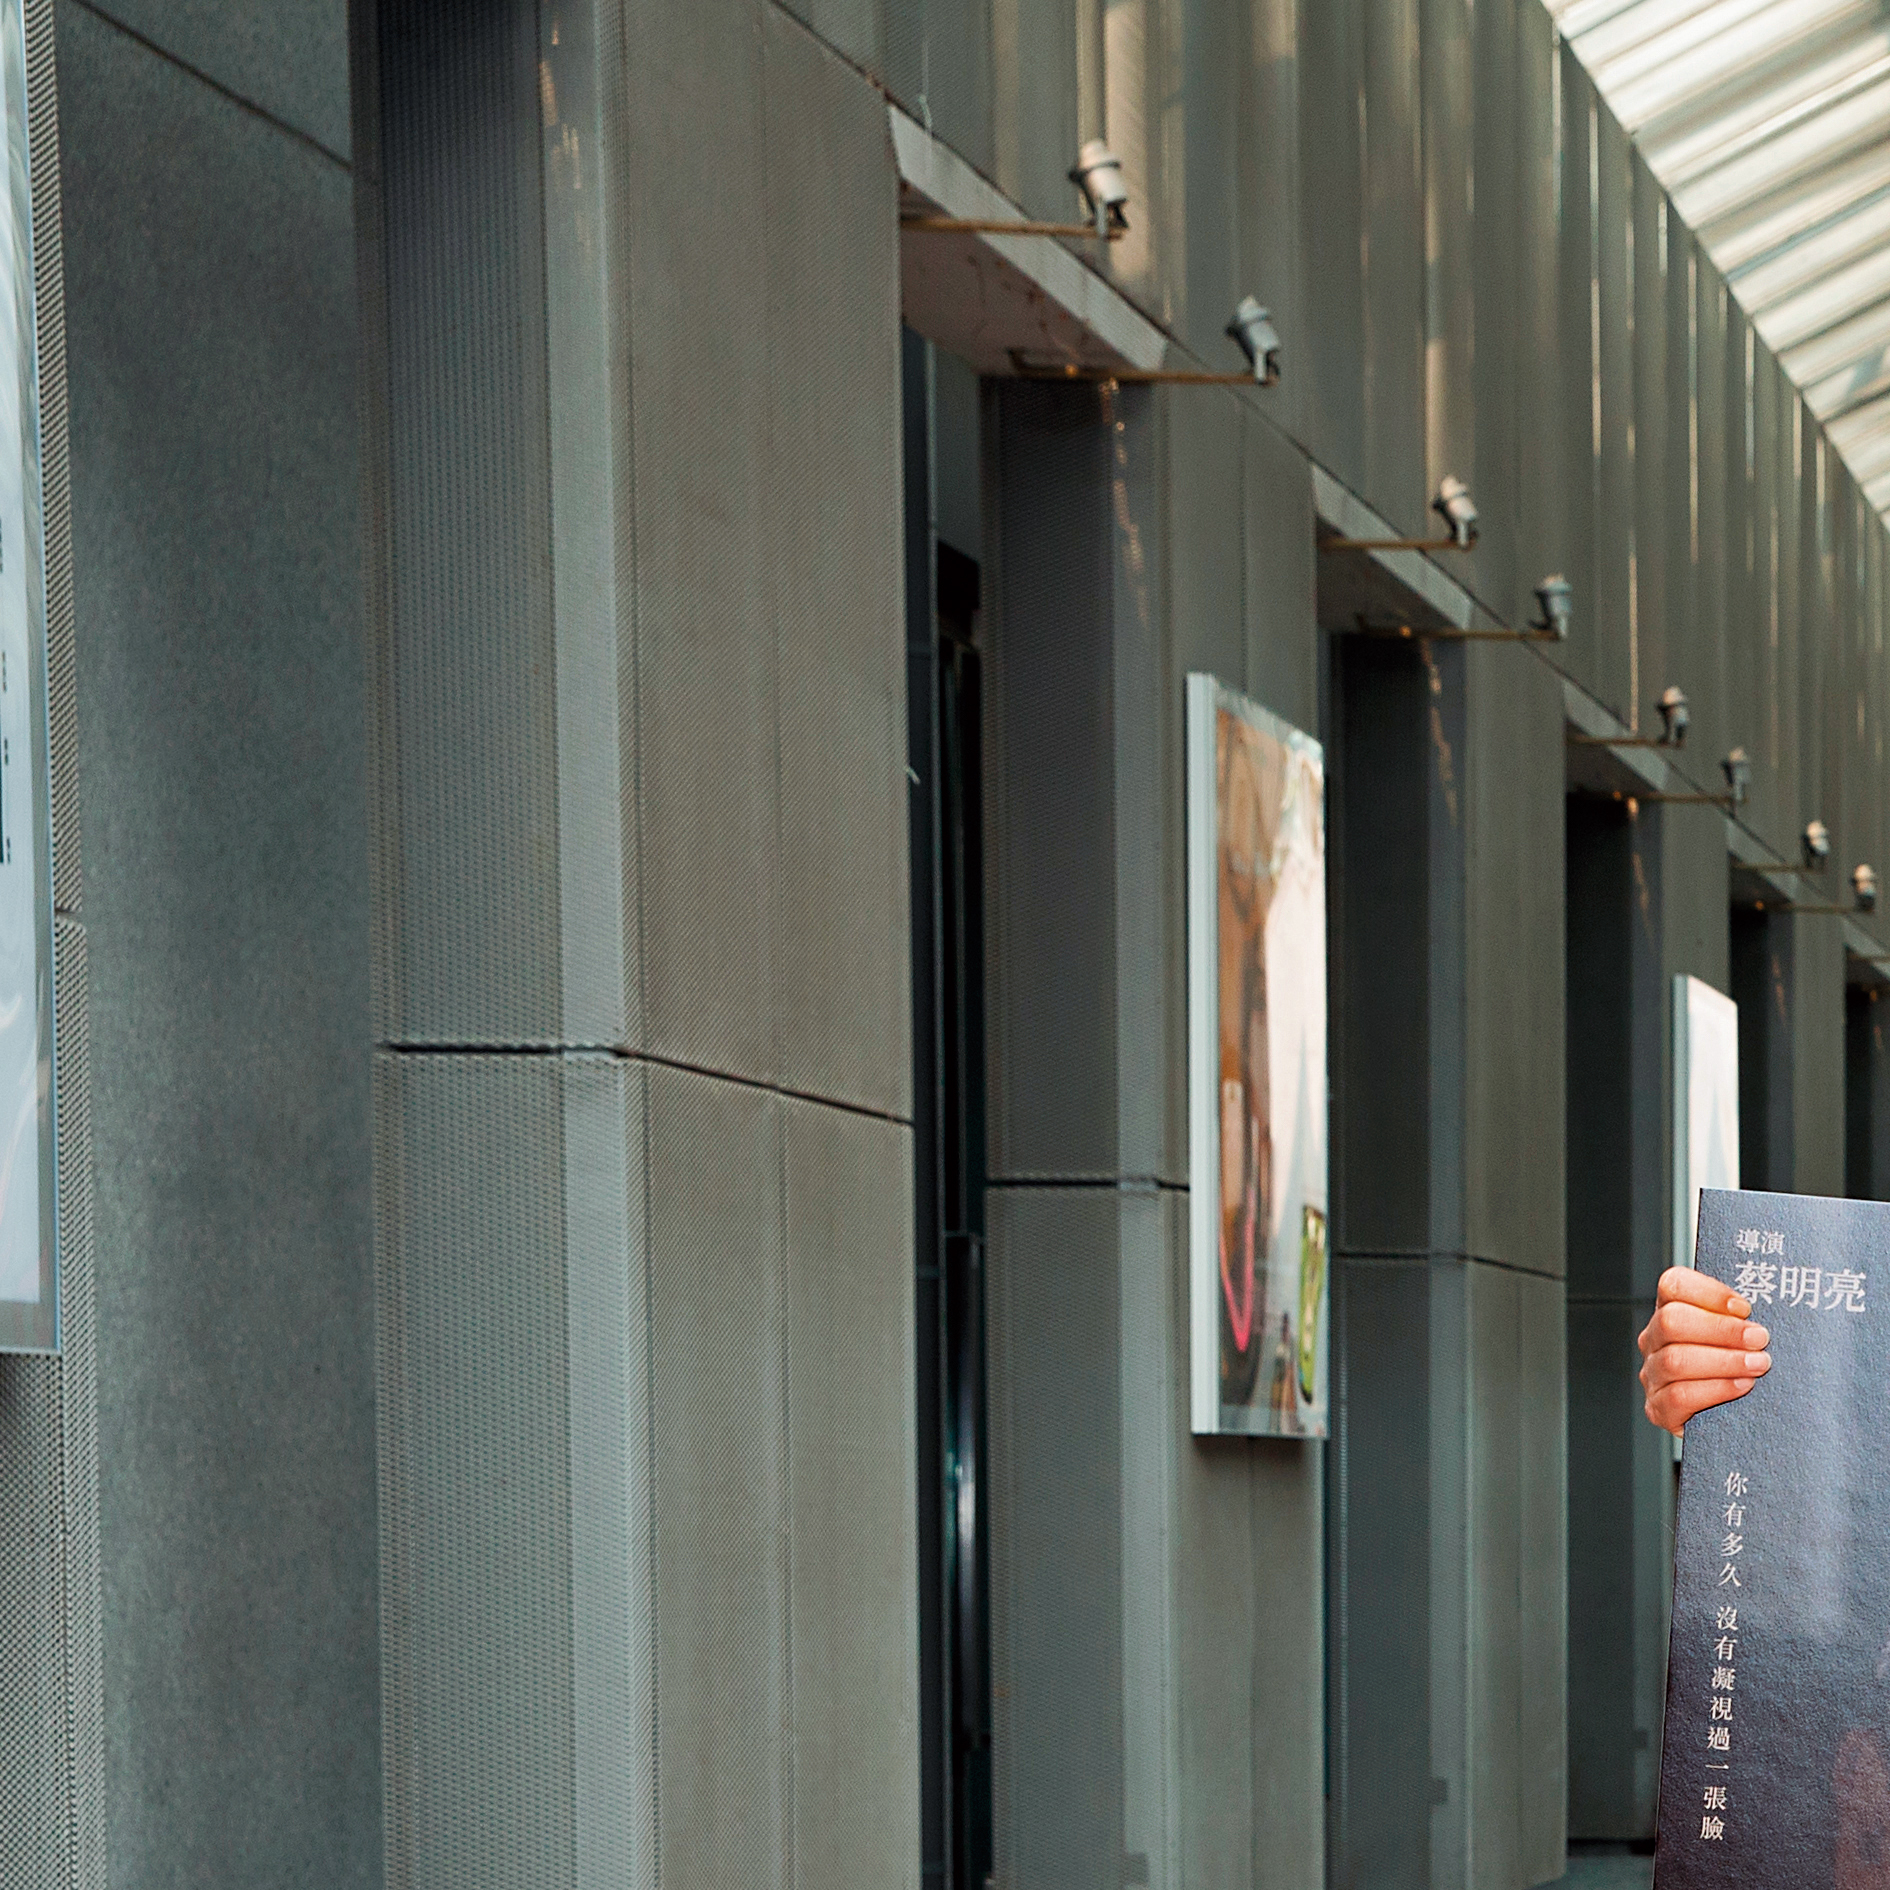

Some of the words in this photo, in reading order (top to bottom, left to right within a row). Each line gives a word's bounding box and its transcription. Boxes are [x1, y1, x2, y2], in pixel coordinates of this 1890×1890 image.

[1735, 1227, 1786, 1256] 導演
[1732, 1259, 1868, 1314] 蔡明亮
[1717, 1471, 1748, 1588] 你有多久
[1699, 1605, 1739, 1841] 沒有凝視過一張臉
